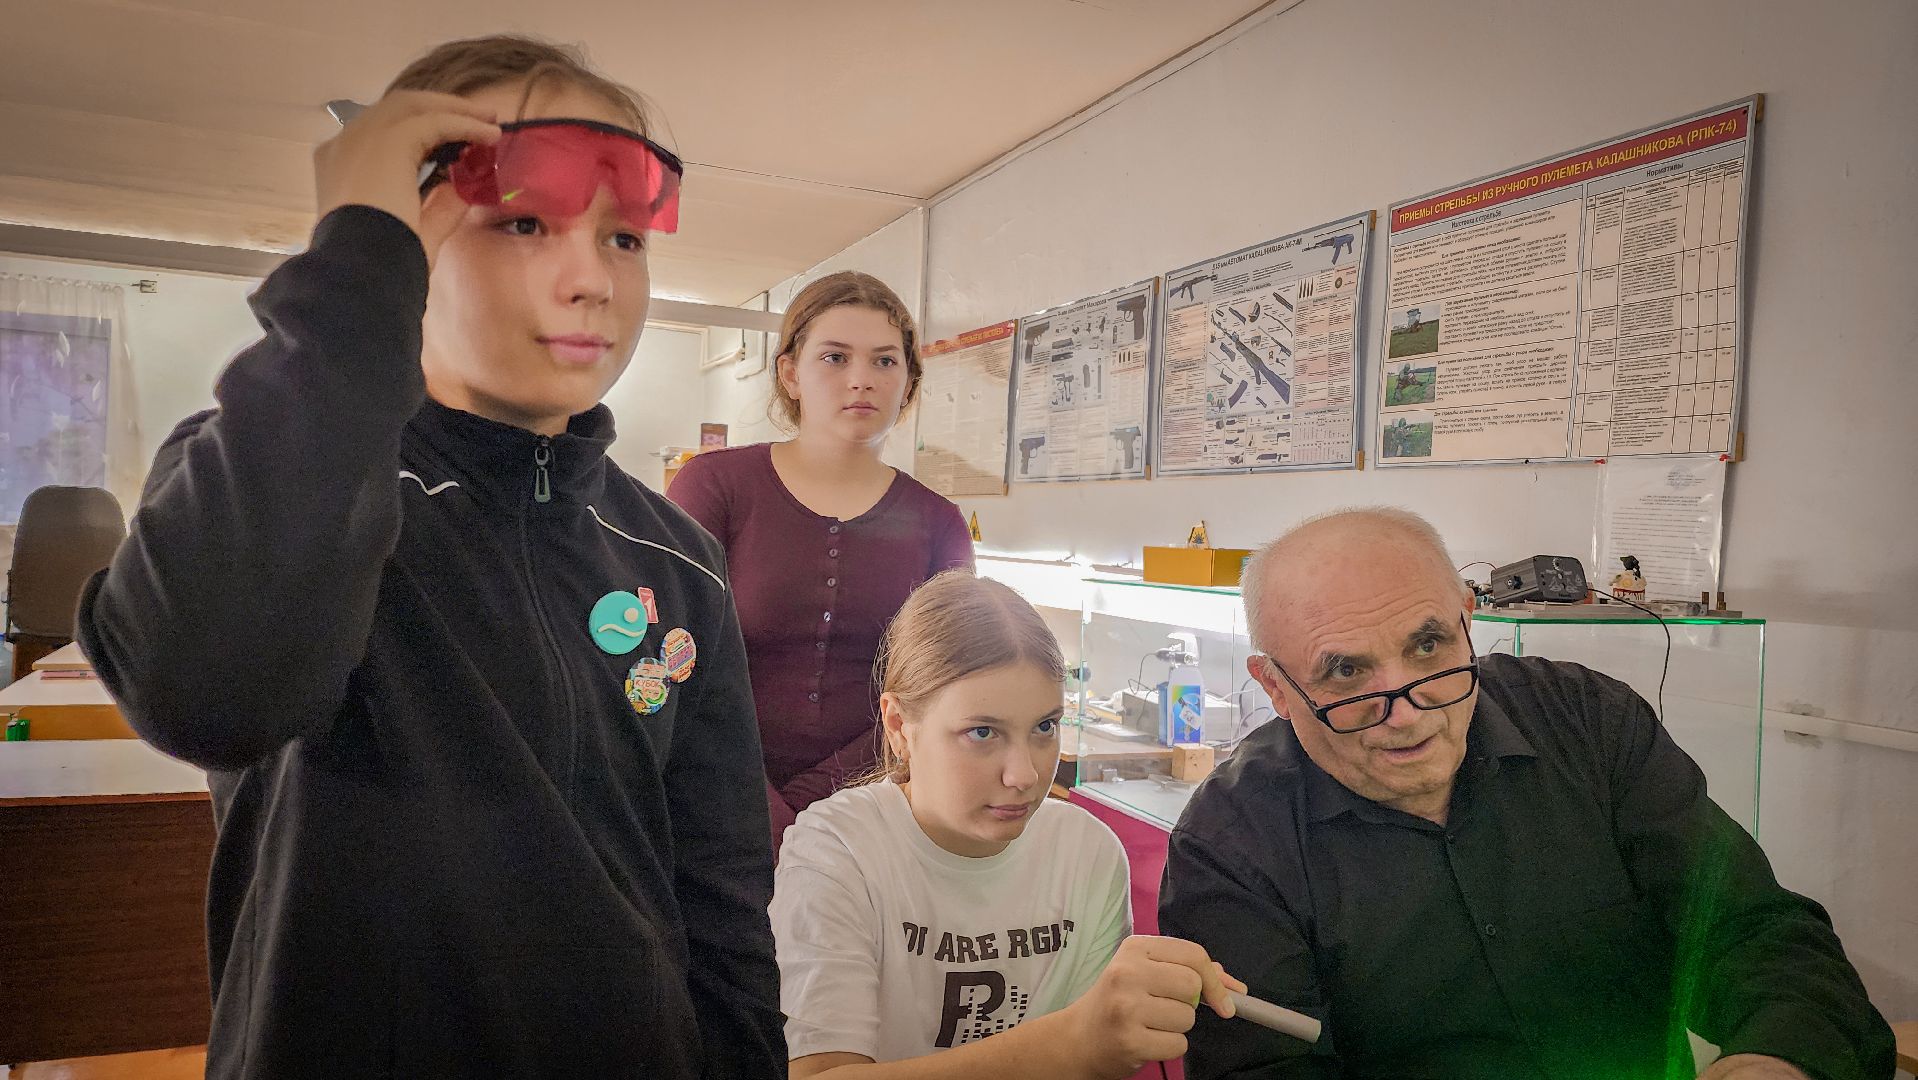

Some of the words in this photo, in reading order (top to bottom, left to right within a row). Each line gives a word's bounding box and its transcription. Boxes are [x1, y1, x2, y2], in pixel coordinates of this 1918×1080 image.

[1399, 206, 1433, 224] ПРИЕМЫ
[1434, 192, 1480, 214] СТРЕЛЬБЫ
[1482, 188, 1494, 201] ИЗ
[1495, 175, 1539, 197] РУЧНОГО
[1540, 162, 1593, 185] ПУЛЕМЕТА
[1596, 135, 1684, 168] КАЛАШНИКОВА
[1687, 118, 1737, 146] (РПК-74)
[1646, 163, 1684, 177] Нормативы
[934, 932, 999, 963] ARE
